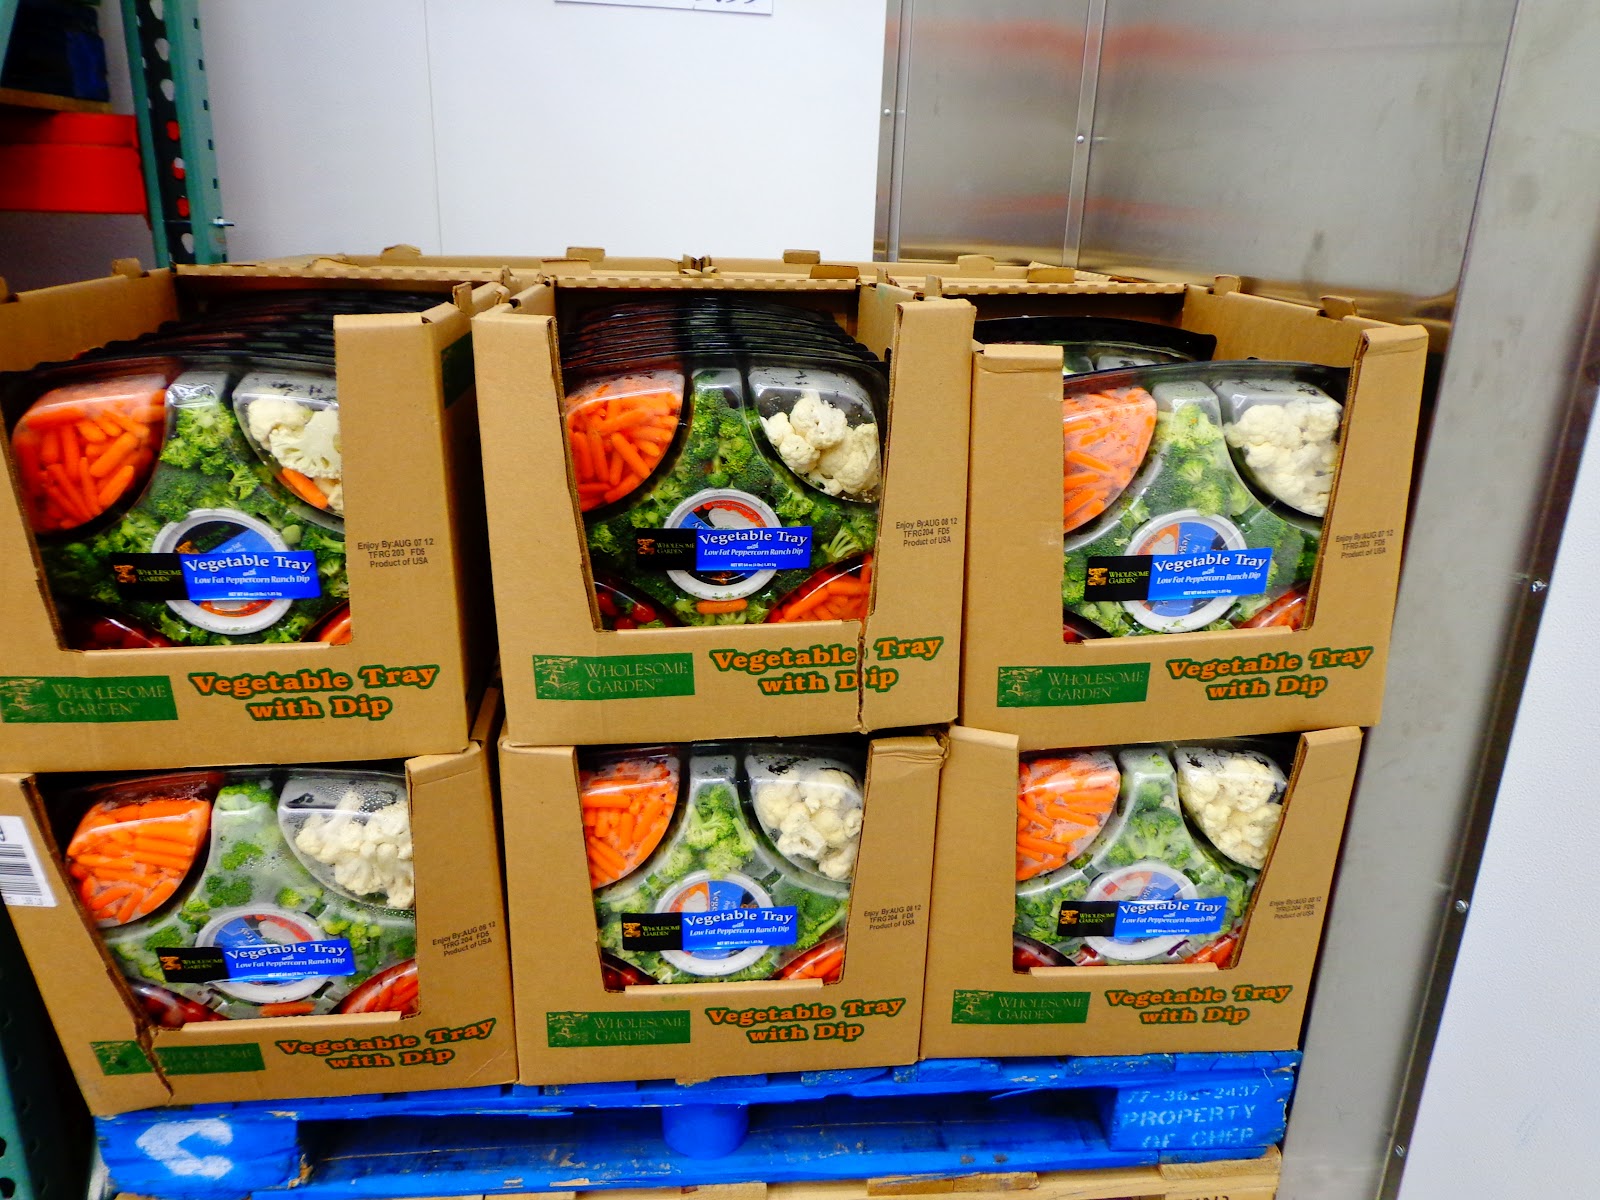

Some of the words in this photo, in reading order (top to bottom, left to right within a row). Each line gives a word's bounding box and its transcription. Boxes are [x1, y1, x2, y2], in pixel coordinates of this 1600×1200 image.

[896, 521, 915, 530] Enjoy
[699, 530, 772, 545] Vegetable
[777, 531, 808, 546] Tray
[903, 539, 928, 547] Product
[938, 536, 951, 544] USA
[358, 542, 379, 551] Enjoy
[731, 549, 769, 557] Peppercorn
[792, 548, 804, 556] Dip
[184, 555, 269, 573] Vegetable
[273, 556, 312, 572] Tray
[370, 560, 401, 568] Product
[402, 558, 410, 566] of
[413, 557, 428, 565] USA
[1153, 555, 1231, 573] Vegetable
[1234, 554, 1268, 570] Tray
[226, 576, 270, 585] Peppercorn
[296, 575, 310, 584] Dip
[1185, 574, 1225, 584] Peppercorn
[1226, 573, 1247, 581] Ranch
[1248, 572, 1261, 581] Dip
[711, 645, 858, 673] Vegetable
[875, 638, 942, 659] Tray
[584, 662, 688, 678] WHOLESOME
[1167, 653, 1301, 681] Vegetable
[1309, 648, 1373, 668] Tray
[190, 669, 351, 698] Vegetable
[360, 666, 438, 688] Tray
[588, 679, 656, 694] GARDEN
[760, 672, 826, 694] with
[837, 668, 897, 691] Dip
[1048, 671, 1145, 686] WHOLESOME
[52, 684, 167, 700] WHOLESOME
[1048, 687, 1112, 700] GARDEN
[1207, 679, 1269, 699] with
[1276, 676, 1327, 697] Dip
[248, 698, 322, 719] with
[331, 696, 391, 719] Dip
[1120, 902, 1189, 914] Vegetable
[1193, 902, 1222, 913] Tray
[684, 910, 757, 925] Vegetable
[761, 911, 793, 924] Tray
[717, 927, 755, 936] Peppercorn
[777, 926, 790, 934] Dip
[433, 936, 451, 945] Enjoy
[444, 945, 469, 957] Product
[478, 938, 492, 946] USA
[226, 945, 306, 960] Vegetable
[310, 944, 347, 956] Tray
[332, 957, 345, 965] Dip
[1105, 987, 1226, 1009] Vegetable
[1233, 985, 1292, 1002] Tray
[706, 1004, 834, 1027] Vegetable
[843, 998, 905, 1017] Tray
[1140, 1007, 1197, 1024] with
[1203, 1006, 1249, 1024] Dip
[594, 1017, 686, 1029] WHOLESOME
[277, 1035, 418, 1055] Vegetable
[427, 1019, 496, 1043] Tray
[748, 1024, 806, 1043] with
[815, 1022, 863, 1041] Dip
[327, 1054, 393, 1069] with
[401, 1049, 454, 1065] Dip
[1122, 1104, 1256, 1127] PROPERTY
